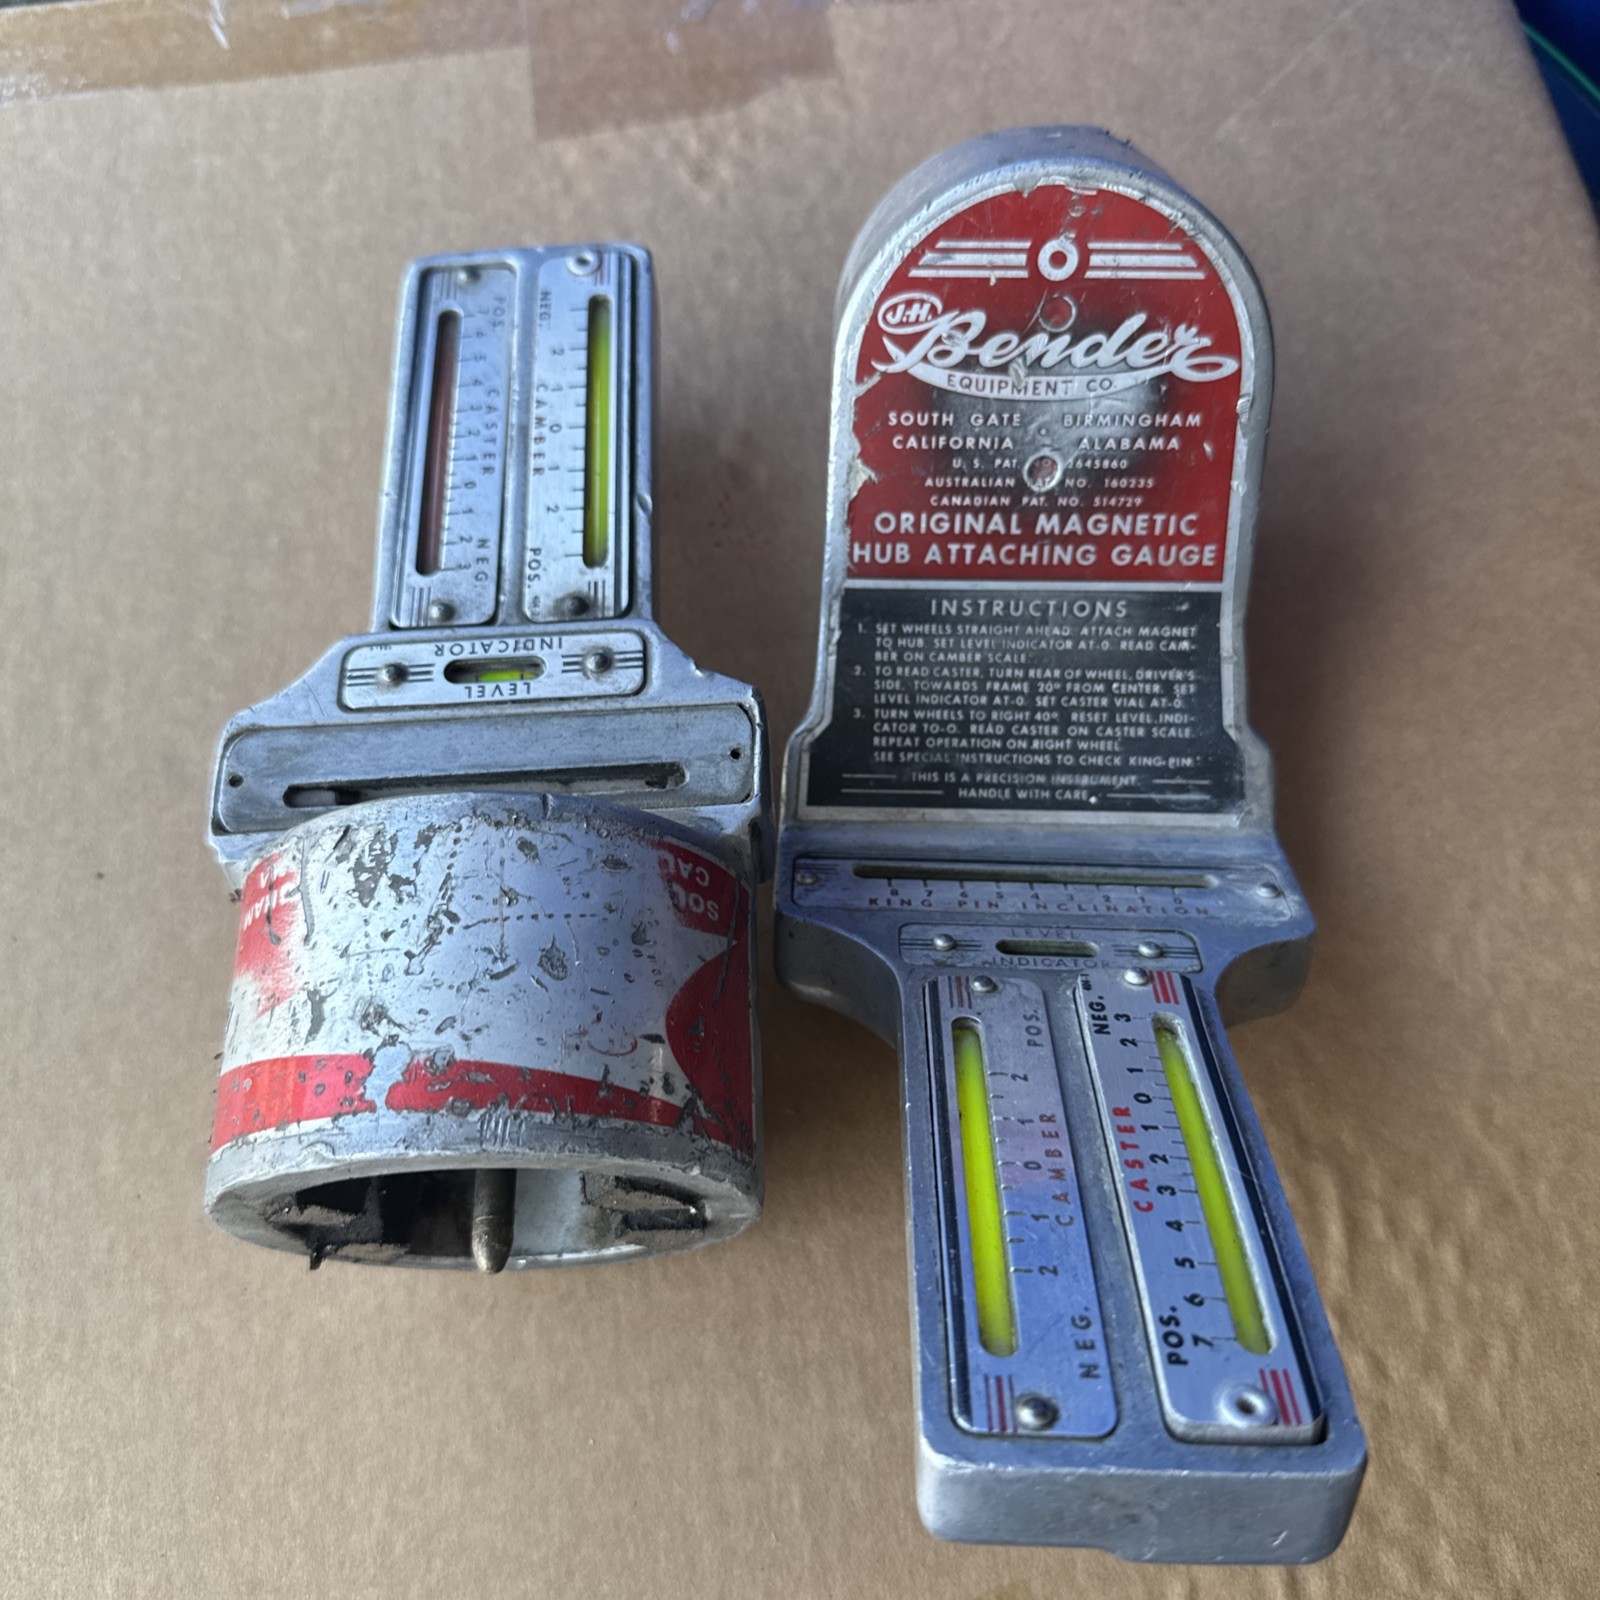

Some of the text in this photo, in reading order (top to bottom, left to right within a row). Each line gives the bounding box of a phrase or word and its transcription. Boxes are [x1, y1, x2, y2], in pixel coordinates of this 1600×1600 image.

[871, 308, 1239, 382] Bender
[947, 374, 1072, 396] EQUIPMENT
[888, 413, 1021, 426] SOUTH GATE
[1064, 414, 1201, 428] BIRMINGHAM
[892, 437, 1013, 450] CALIFORNIA
[1078, 438, 1180, 450] ALABAMA
[924, 477, 1015, 488] AUSTRALIAN
[1104, 479, 1153, 488] 160235
[930, 496, 1010, 506] CANADIAN
[1092, 497, 1142, 507] 514729
[874, 511, 1198, 537] ORIGINAL MAGNETIC
[852, 542, 1216, 567] HUB ATTACHING GAUGE
[931, 599, 1128, 618] INSTRUCTIONS
[875, 623, 897, 635] SET
[902, 624, 951, 635] WHEELS
[957, 625, 1020, 636] STRAIGHT
[1080, 626, 1132, 636] ATTACH
[1138, 626, 1198, 637] MAGNET
[434, 636, 562, 656] INDICATOR
[934, 639, 954, 649] SET
[960, 639, 996, 649] LEVEL
[1002, 640, 1073, 650] INDICATOR
[1120, 641, 1154, 651] READ
[874, 651, 897, 662] BER
[903, 651, 924, 662] ON
[929, 652, 981, 663] CAMBER
[875, 666, 892, 676] TO
[896, 666, 929, 677] READ
[989, 667, 1024, 678] TURN
[1028, 669, 1060, 679] REAR
[1064, 669, 1082, 680] OF
[464, 682, 531, 699] LEVEL
[913, 681, 978, 691] TOWARDS
[986, 681, 1029, 693] FRAME
[1066, 682, 1105, 694] FROM
[874, 694, 910, 705] LEVEL
[916, 694, 987, 706] INDICATOR
[1035, 696, 1056, 707] SET
[1061, 696, 1108, 707] CASTER
[1114, 697, 1145, 708] VIAL
[874, 708, 909, 719] TURN
[913, 709, 963, 720] WHEELS
[969, 710, 986, 720] TO
[991, 710, 1030, 721] RIGHT
[1070, 712, 1108, 723] RESET
[873, 723, 917, 733] CATOR
[970, 724, 1004, 735] READ
[1011, 725, 1059, 736] CASTER
[1067, 726, 1089, 736] ON
[1096, 726, 1145, 737] CASTER
[873, 736, 920, 748] REPEAT
[925, 737, 1001, 748] OPERATION
[1006, 739, 1027, 750] ON
[874, 751, 894, 762] SEE
[899, 752, 950, 763] SPECIAL
[955, 752, 1050, 764] INSTRUCTIONS
[1056, 755, 1074, 765] TO
[1079, 755, 1122, 766] CHECK
[911, 772, 939, 782] THIS
[944, 772, 956, 782] IS
[961, 773, 970, 782] A
[976, 773, 1046, 785] PRECISION
[958, 788, 1011, 799] HANDLE
[1016, 789, 1050, 799] WITH
[869, 898, 1208, 915] KING PIN INCLINATION
[1011, 929, 1081, 939] LEVEL
[992, 957, 1111, 969] INDICATOR
[1088, 995, 1111, 1035] NEG.
[1114, 1013, 1131, 1022] 3
[1023, 1010, 1044, 1048] POS.
[1120, 1038, 1138, 1047] 2
[1011, 1073, 1029, 1082] 2
[1133, 1092, 1152, 1104] 0
[1112, 1107, 1154, 1212] CASTER
[1149, 1153, 1169, 1164] 2
[1023, 1160, 1042, 1171] 0
[1039, 1113, 1075, 1227] CAMBER
[1157, 1185, 1176, 1196] 3
[1031, 1214, 1050, 1222] 1
[1165, 1220, 1184, 1232] 4
[1174, 1257, 1195, 1269] 5
[1038, 1265, 1059, 1276] 2
[1183, 1293, 1205, 1307] 6
[1071, 1306, 1100, 1379] NEG.
[1159, 1306, 1189, 1366] POS.
[1191, 1334, 1214, 1347] 7
